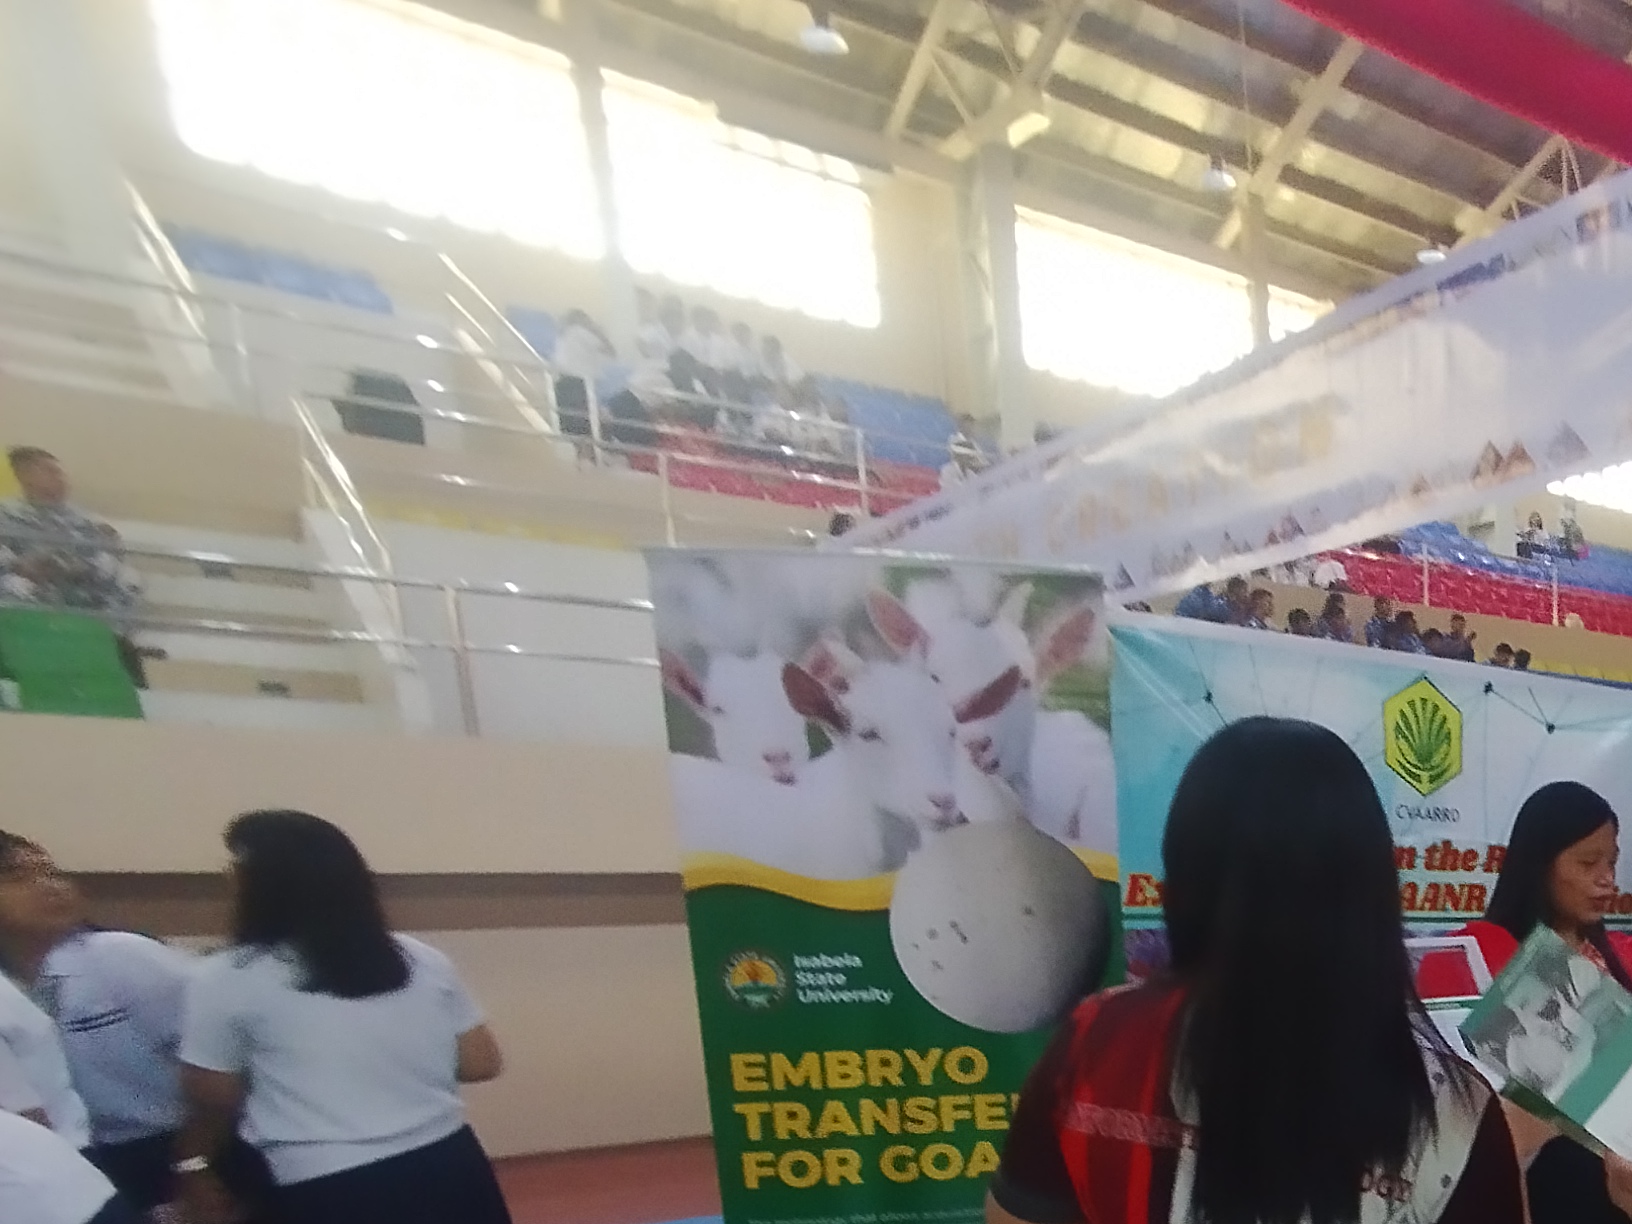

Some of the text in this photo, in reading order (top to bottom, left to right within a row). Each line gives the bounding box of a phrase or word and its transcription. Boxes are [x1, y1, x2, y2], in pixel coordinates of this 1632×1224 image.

[1424, 840, 1479, 872] the
[793, 952, 863, 968] Isabela
[795, 971, 847, 986] State
[797, 986, 893, 1005] University
[730, 1046, 989, 1091] EMBRYO
[742, 1141, 1000, 1189] FOR GOA
